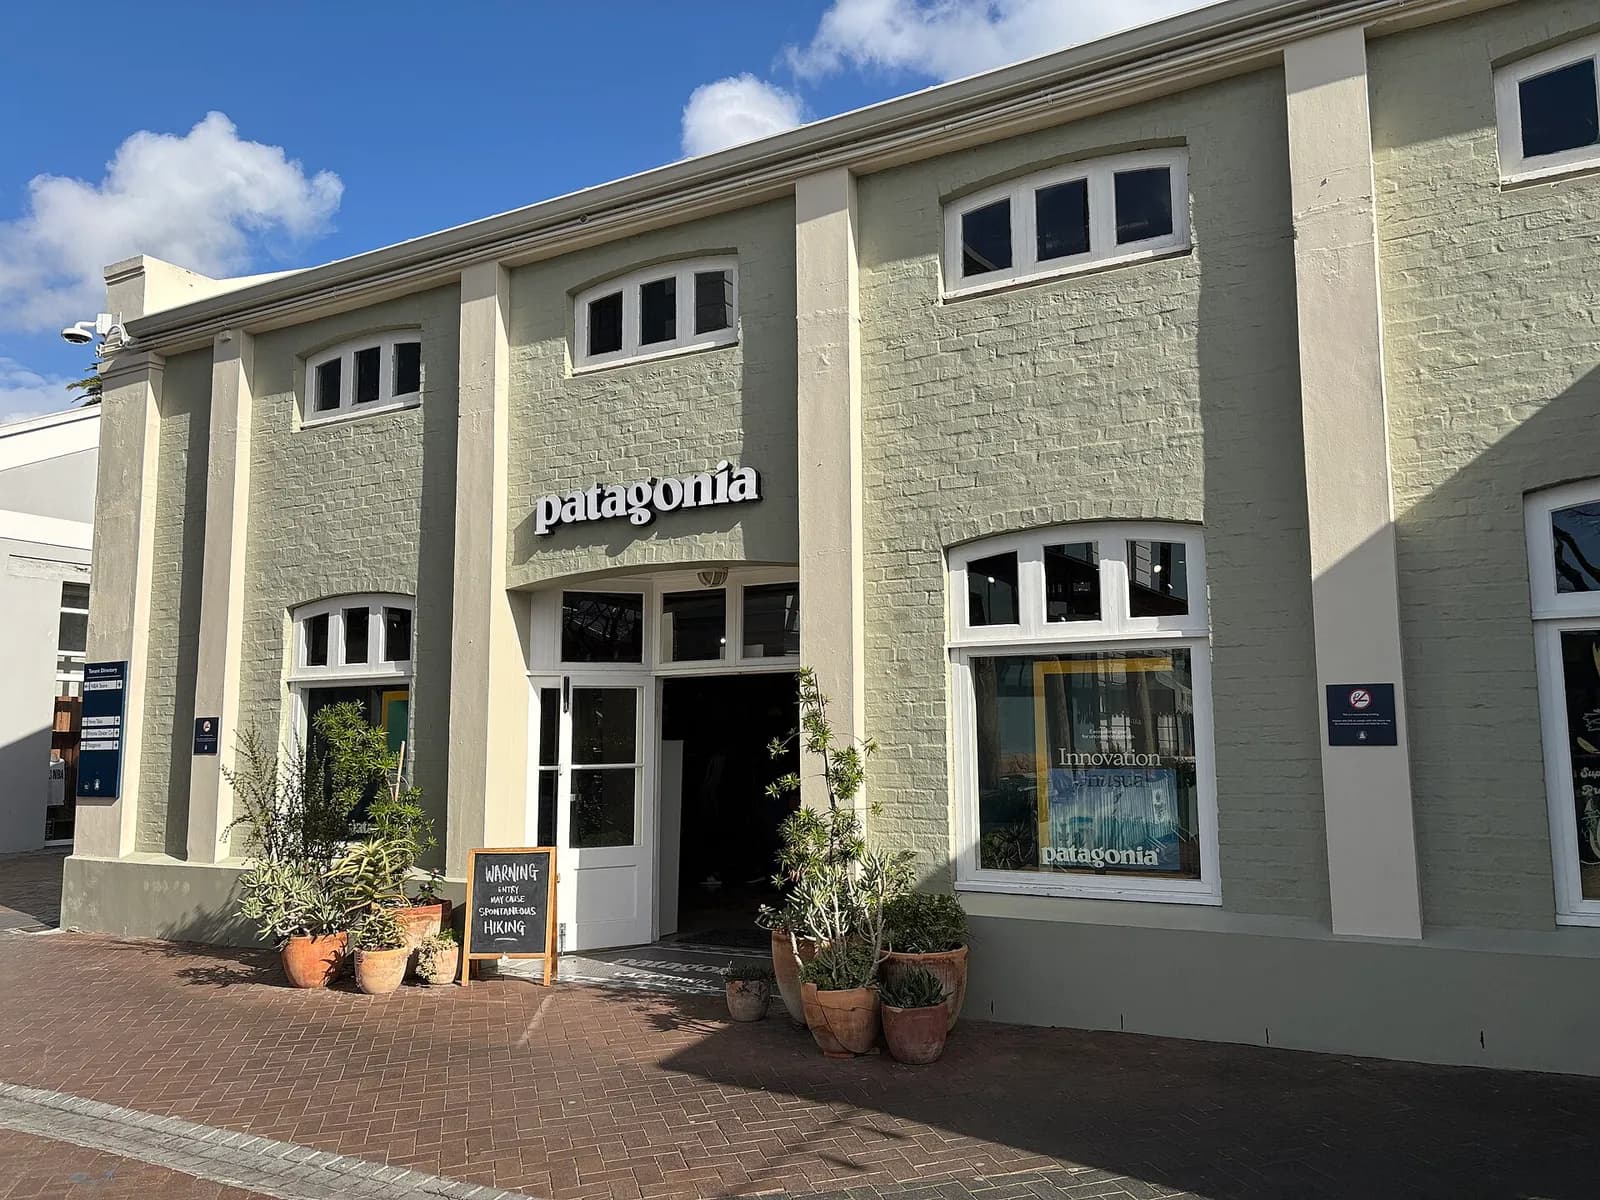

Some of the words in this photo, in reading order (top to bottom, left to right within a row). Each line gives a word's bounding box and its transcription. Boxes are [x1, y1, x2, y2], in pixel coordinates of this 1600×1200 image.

[534, 460, 760, 535] patagonia
[1058, 747, 1162, 766] Innovation
[1041, 845, 1160, 868] patagonia
[485, 863, 540, 882] WARNING
[498, 885, 519, 894] ENTRY
[490, 896, 504, 905] MAY
[505, 895, 526, 904] CAUSE
[478, 907, 537, 917] SPONTANEOUS
[484, 920, 527, 936] HIKING
